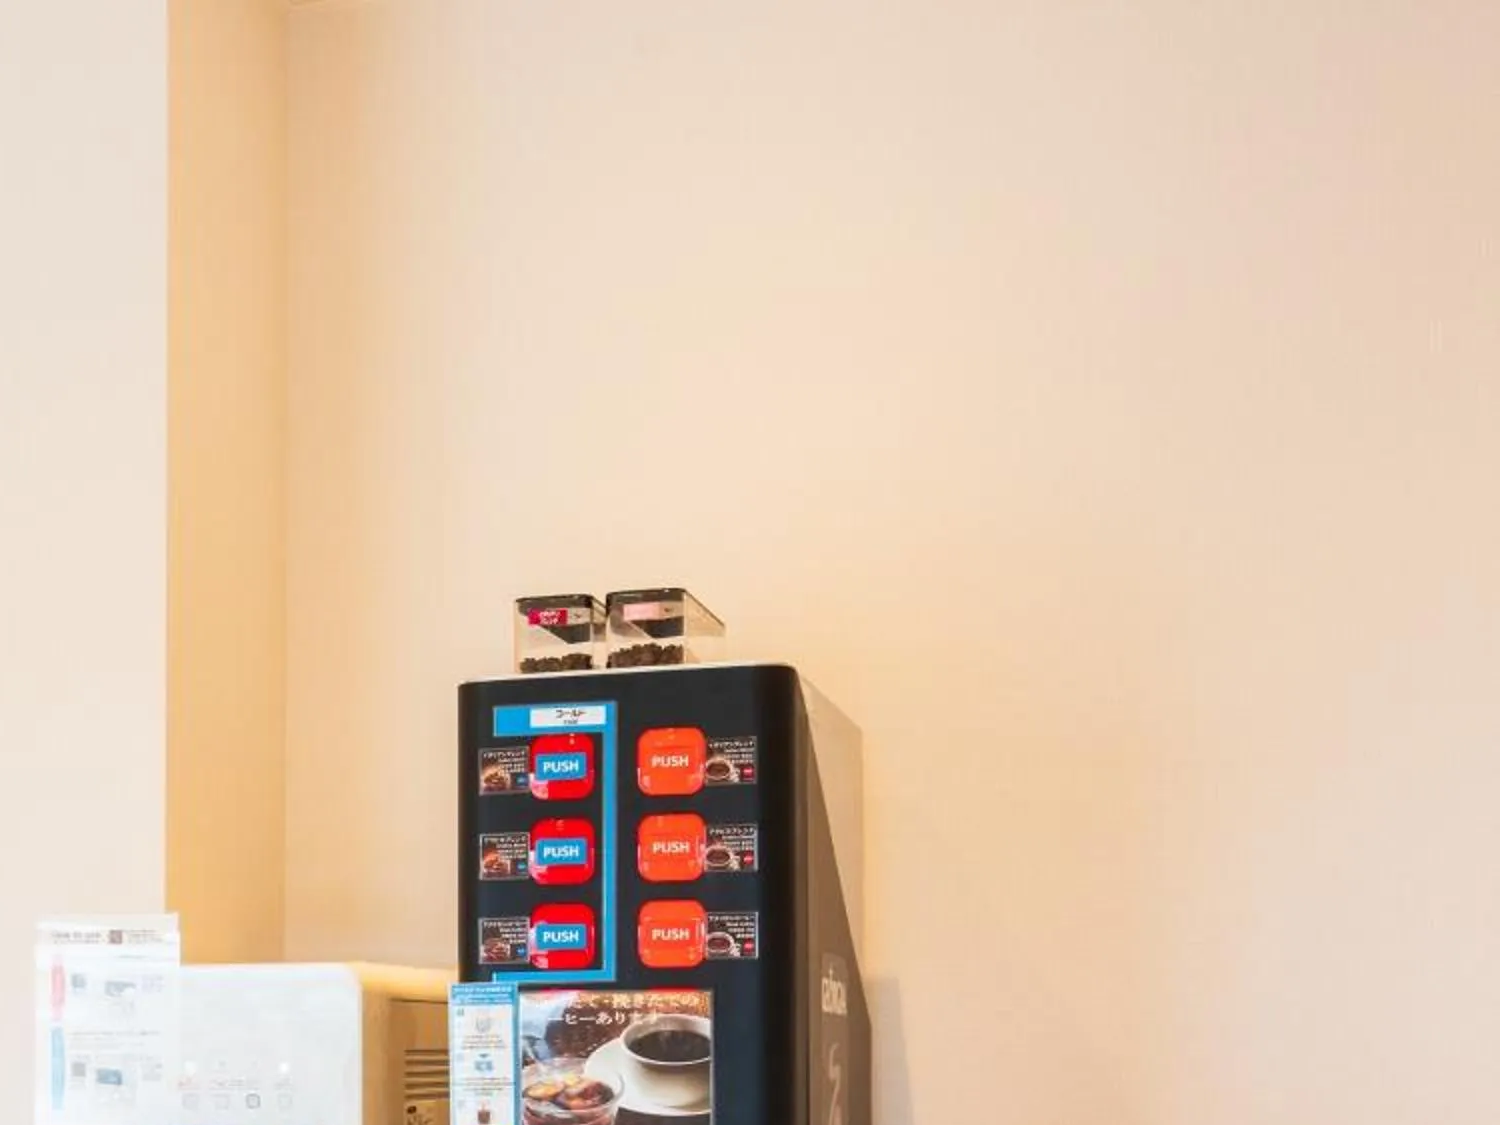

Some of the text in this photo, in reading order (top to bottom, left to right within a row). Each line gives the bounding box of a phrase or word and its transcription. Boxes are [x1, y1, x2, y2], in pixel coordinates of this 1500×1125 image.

[543, 760, 579, 774] PUSH
[651, 753, 689, 768] PUSH
[543, 844, 579, 859] PUSH
[652, 840, 690, 855] PUSH
[543, 928, 579, 943] PUSH
[652, 927, 690, 941] PUSH
